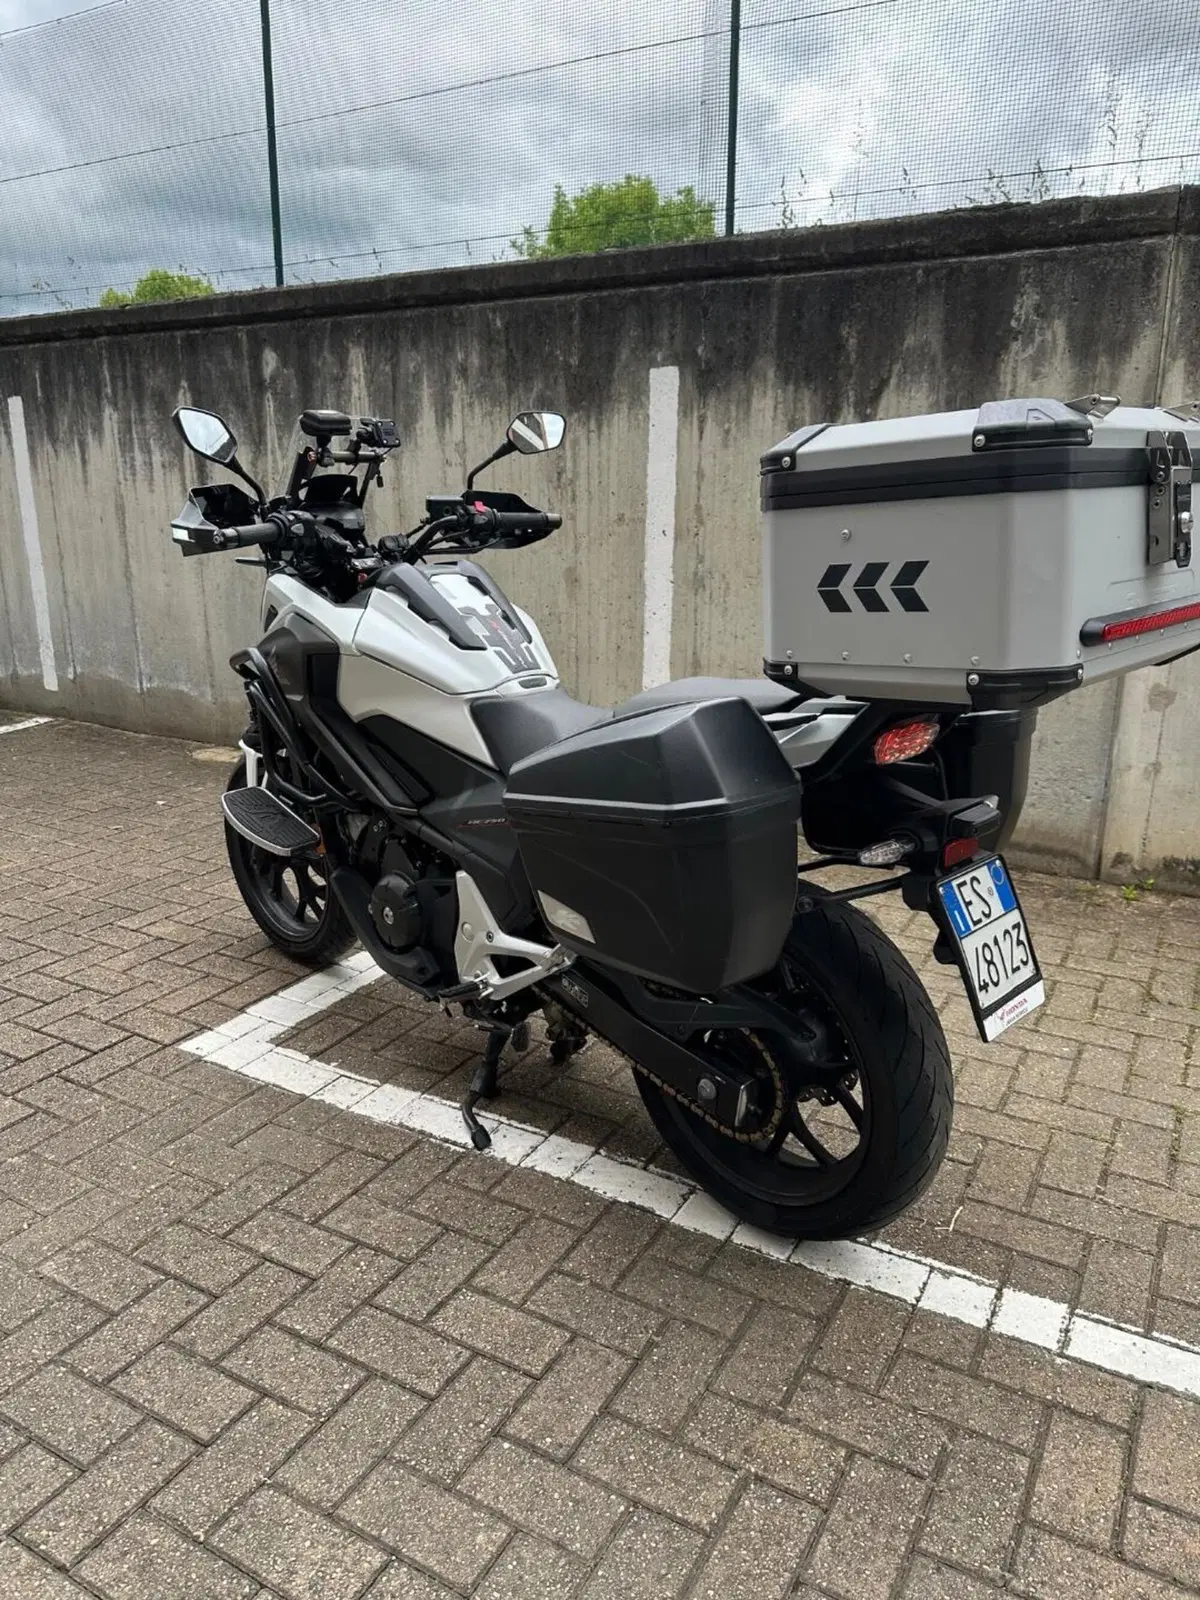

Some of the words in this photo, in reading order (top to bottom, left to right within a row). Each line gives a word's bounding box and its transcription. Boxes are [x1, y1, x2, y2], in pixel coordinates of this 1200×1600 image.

[954, 910, 966, 931] I
[956, 875, 992, 927] ES
[975, 921, 1029, 994] 48123
